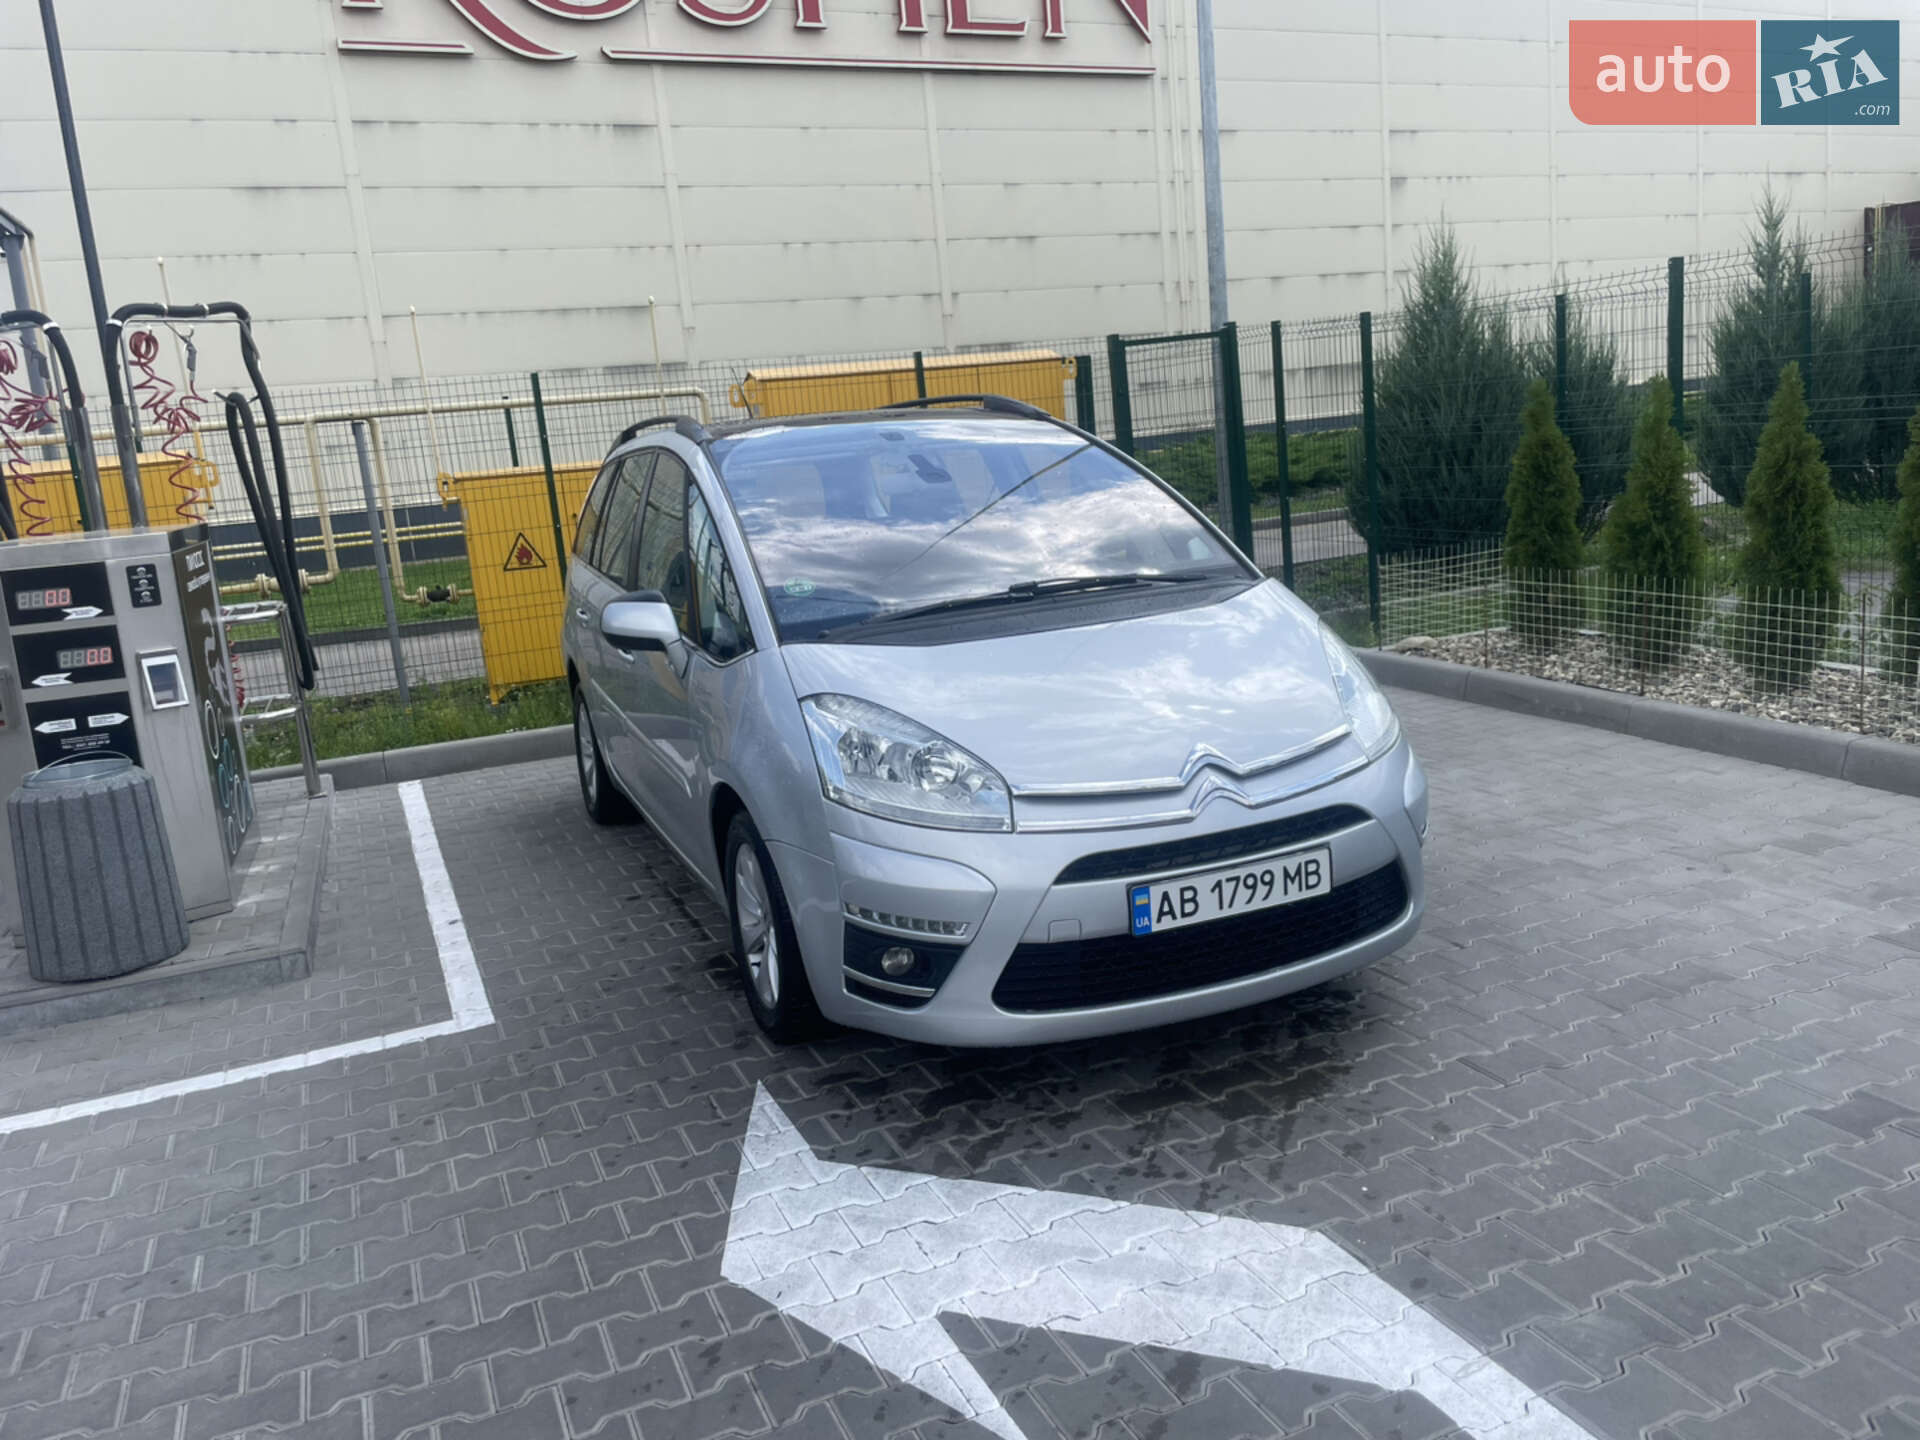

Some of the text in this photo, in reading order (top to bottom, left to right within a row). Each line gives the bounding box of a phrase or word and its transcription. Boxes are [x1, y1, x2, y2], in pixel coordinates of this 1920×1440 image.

[1156, 858, 1322, 924] AB 1799 MB
[1135, 916, 1150, 929] UA
